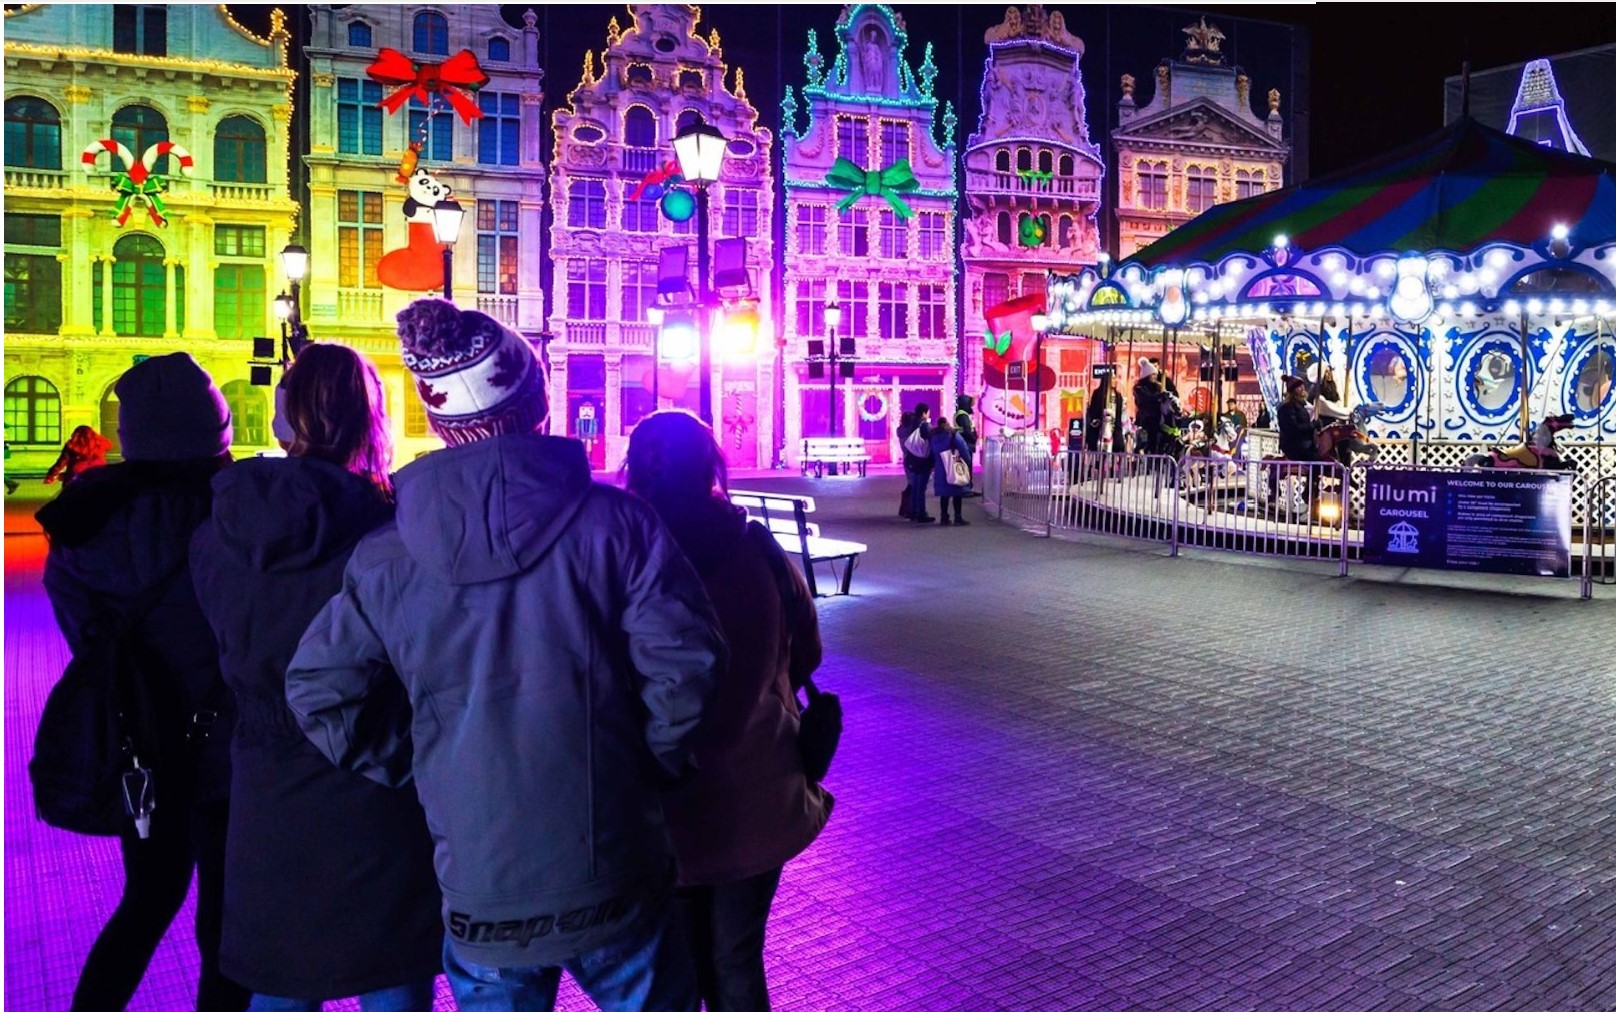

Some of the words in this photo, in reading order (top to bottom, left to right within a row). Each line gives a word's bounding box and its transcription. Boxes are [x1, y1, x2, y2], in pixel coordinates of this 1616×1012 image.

[1497, 481, 1513, 489] OUR
[1515, 482, 1556, 490] CAROUS
[1372, 483, 1437, 504] illumi
[1380, 508, 1429, 518] CAROUSEL
